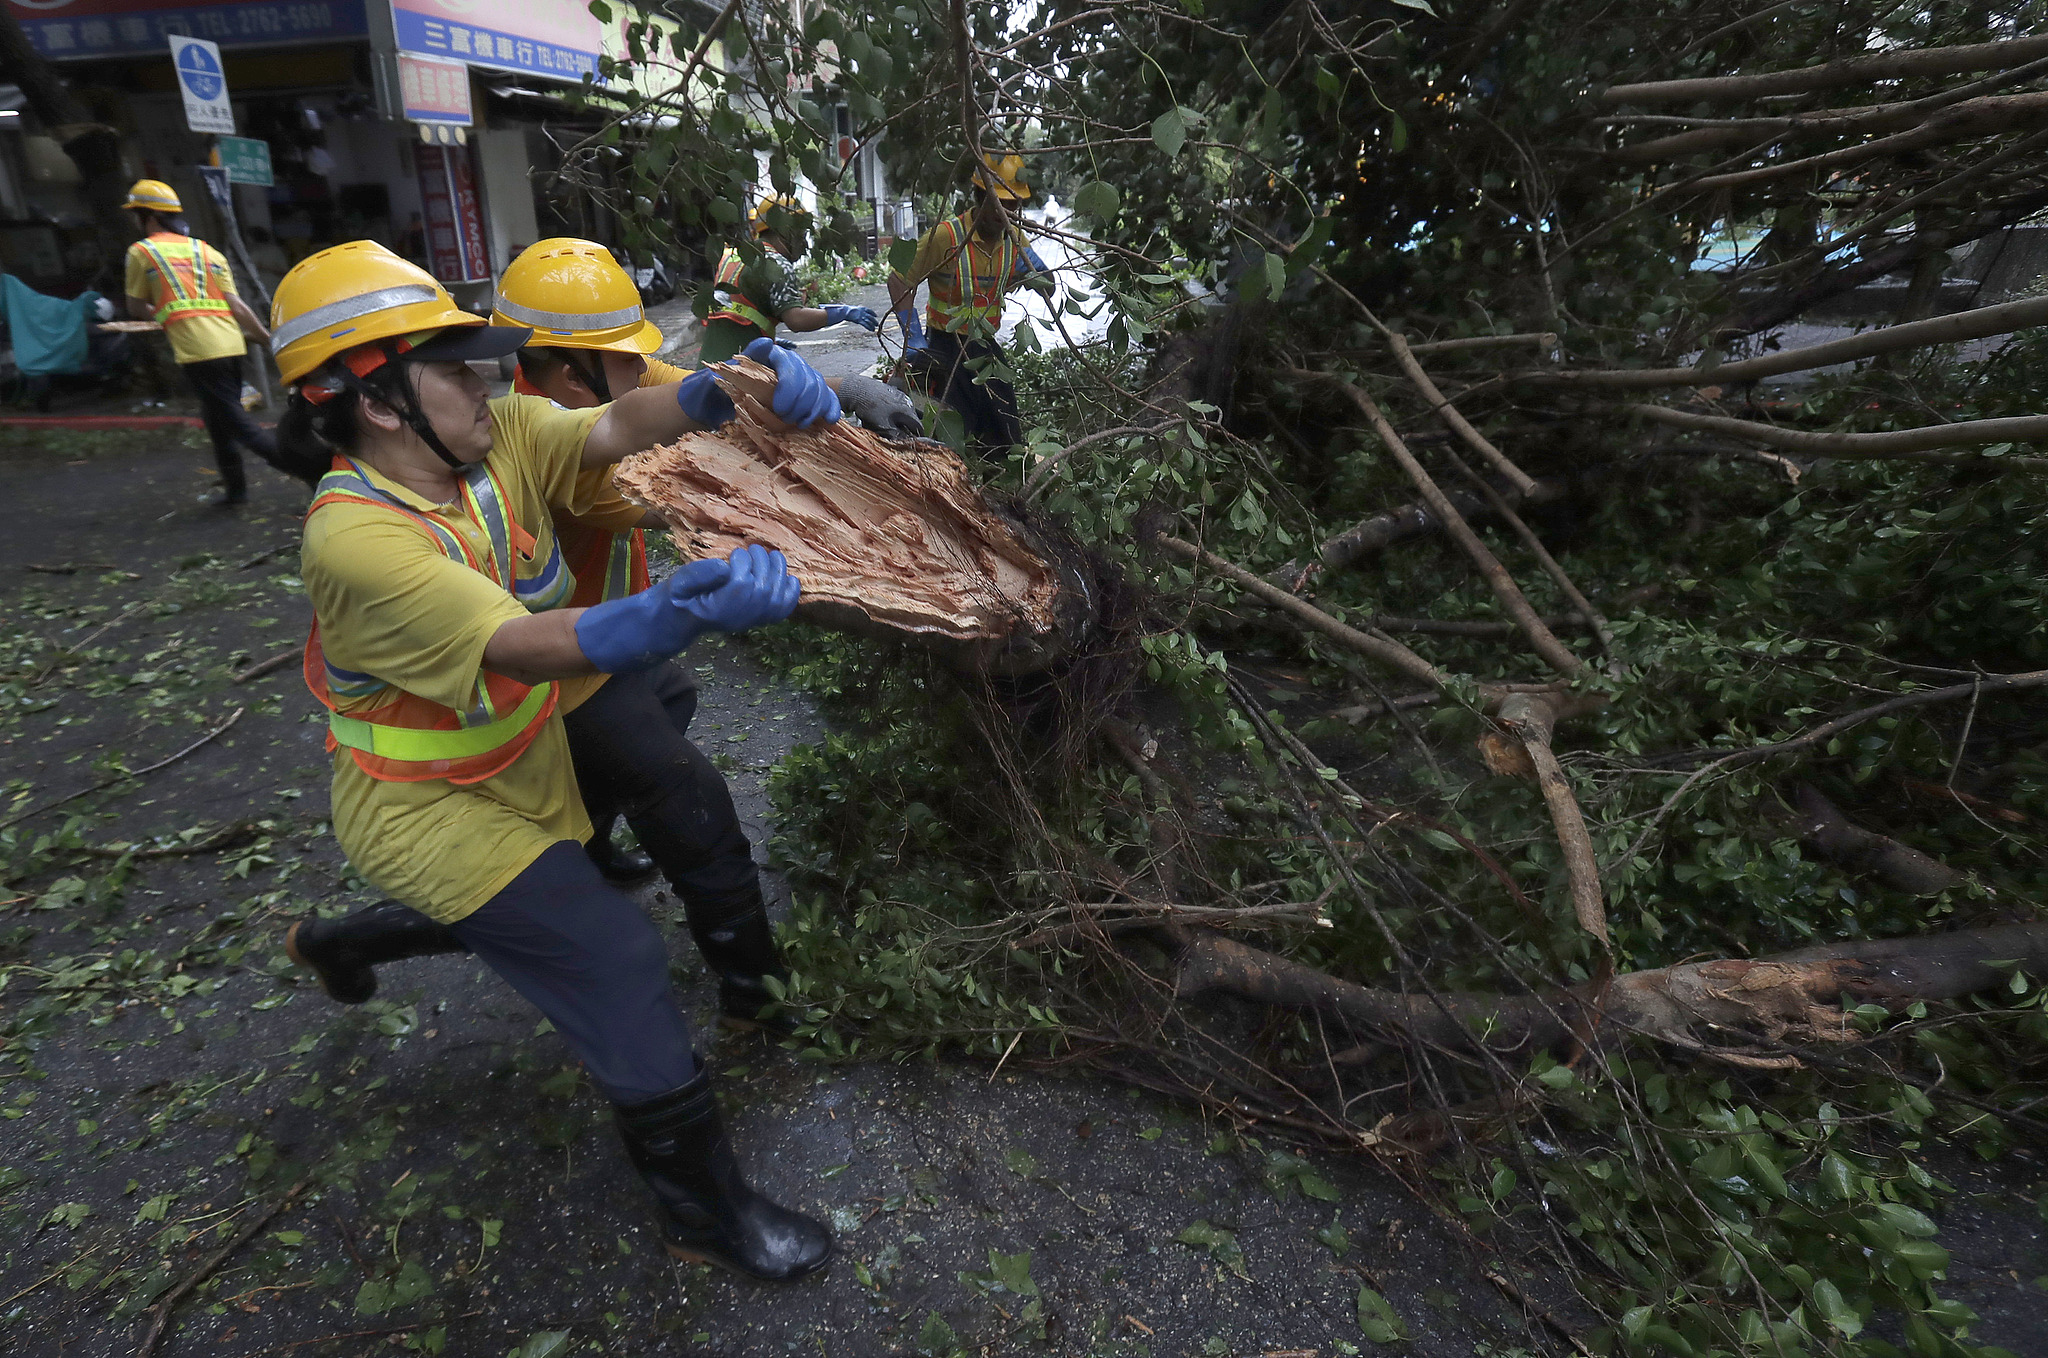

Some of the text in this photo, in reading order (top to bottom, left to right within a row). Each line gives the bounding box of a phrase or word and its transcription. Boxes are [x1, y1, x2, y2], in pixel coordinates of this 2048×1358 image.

[424, 21, 533, 66] 三富機車行
[463, 189, 485, 276] KYMCO
